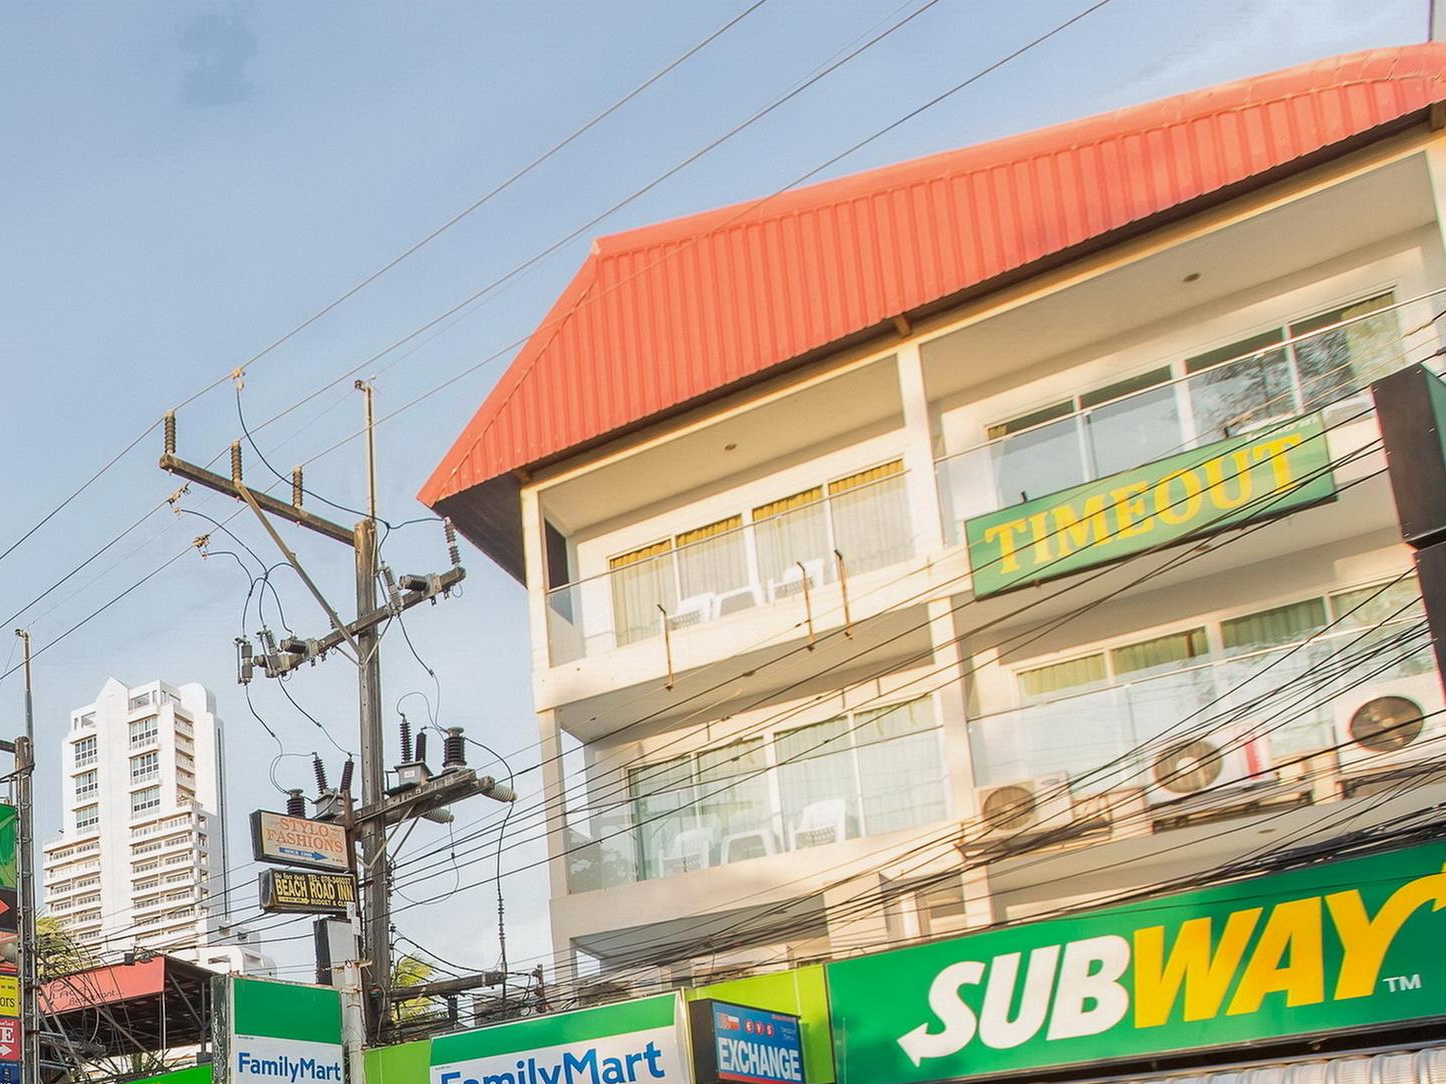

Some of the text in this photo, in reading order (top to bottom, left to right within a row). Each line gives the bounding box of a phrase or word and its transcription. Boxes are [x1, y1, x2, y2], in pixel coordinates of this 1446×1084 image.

[985, 433, 1303, 576] TIMEOUT
[266, 828, 343, 853] FASHIONS
[280, 817, 329, 837] STYLO
[275, 879, 354, 901] BEACH ROAD INN
[897, 868, 1446, 1068] SUBWAY
[1382, 973, 1422, 993] TM
[238, 1051, 342, 1083] FamilyMart
[718, 1036, 802, 1081] EXCHANGE
